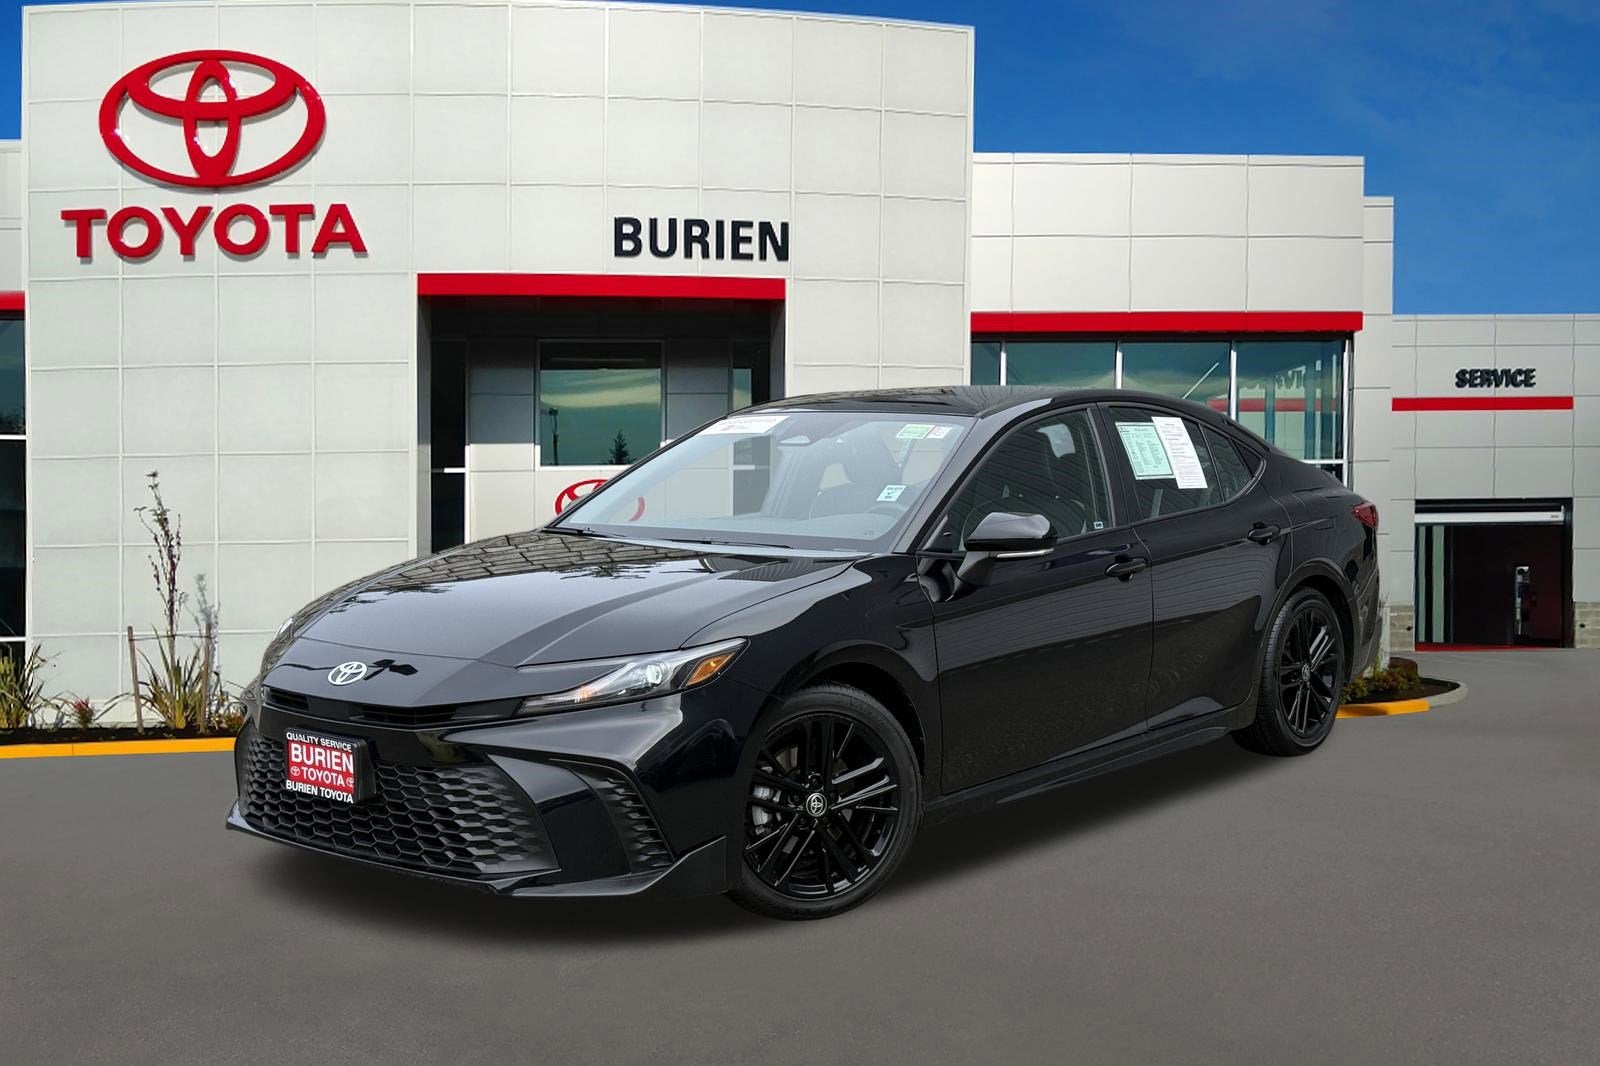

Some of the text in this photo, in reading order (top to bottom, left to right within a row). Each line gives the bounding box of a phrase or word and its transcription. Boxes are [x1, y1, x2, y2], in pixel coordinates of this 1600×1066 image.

[61, 204, 366, 258] TOYOTA
[614, 217, 789, 261] BURIEN
[1455, 368, 1536, 388] SERVICE
[286, 732, 352, 752] QUALITY SERVICE
[291, 743, 354, 774] BURIEN
[302, 766, 346, 787] TOYOTA
[286, 780, 354, 804] BURIEN TOYOTA
